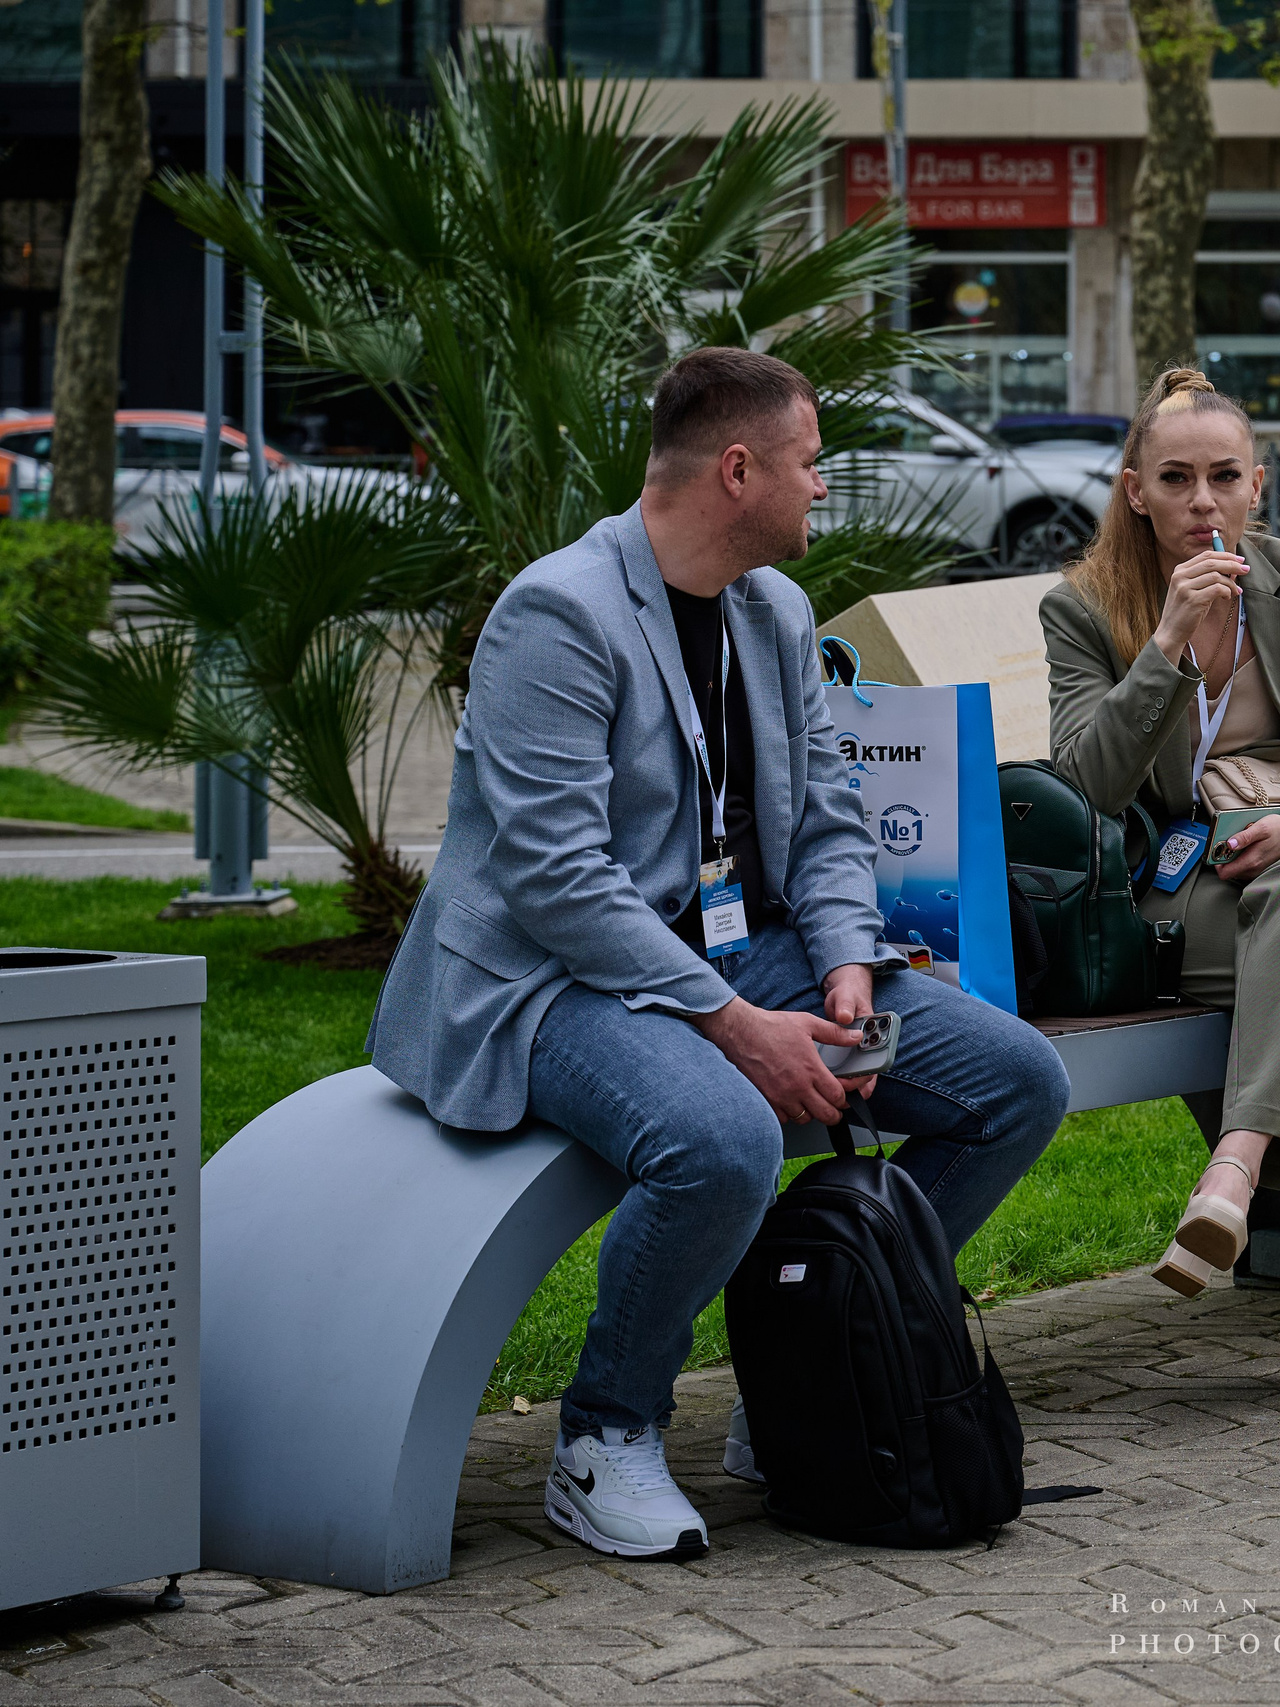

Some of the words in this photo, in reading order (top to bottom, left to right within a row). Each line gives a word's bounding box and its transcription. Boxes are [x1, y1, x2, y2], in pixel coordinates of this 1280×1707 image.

[853, 153, 889, 183] Вс
[913, 153, 972, 184] Для
[980, 153, 1053, 186] Бара
[927, 201, 973, 220] FOR
[978, 201, 1023, 220] BAR
[886, 805, 915, 814] CLINICALLY
[889, 847, 914, 857] APPROVED
